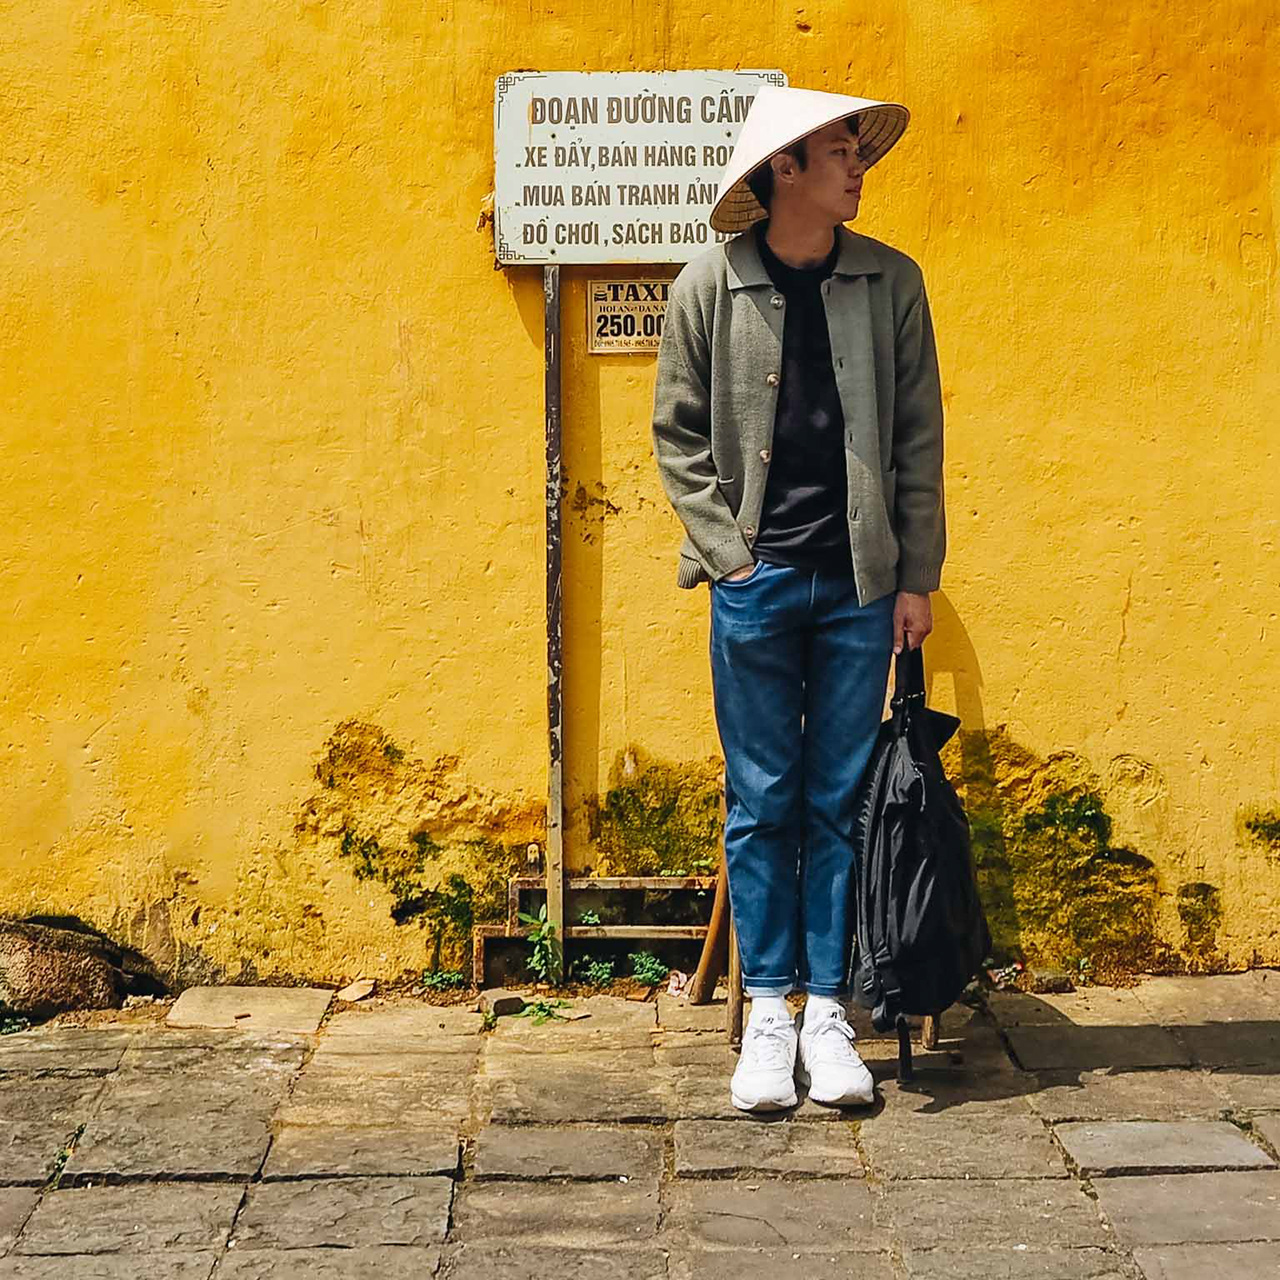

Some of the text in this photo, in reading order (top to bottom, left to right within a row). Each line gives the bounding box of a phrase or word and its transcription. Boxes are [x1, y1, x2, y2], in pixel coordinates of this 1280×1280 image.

[531, 96, 598, 130] ĐOẠN
[606, 88, 692, 124] ĐƯỜNG
[644, 140, 696, 167] HÀNG
[703, 145, 734, 167] RO
[571, 180, 611, 206] BÁN
[617, 184, 679, 206] TRANH
[522, 215, 548, 245] ĐỒ
[670, 218, 708, 244] BÁO
[607, 283, 669, 302] TAXI
[596, 314, 665, 338] 250.00
